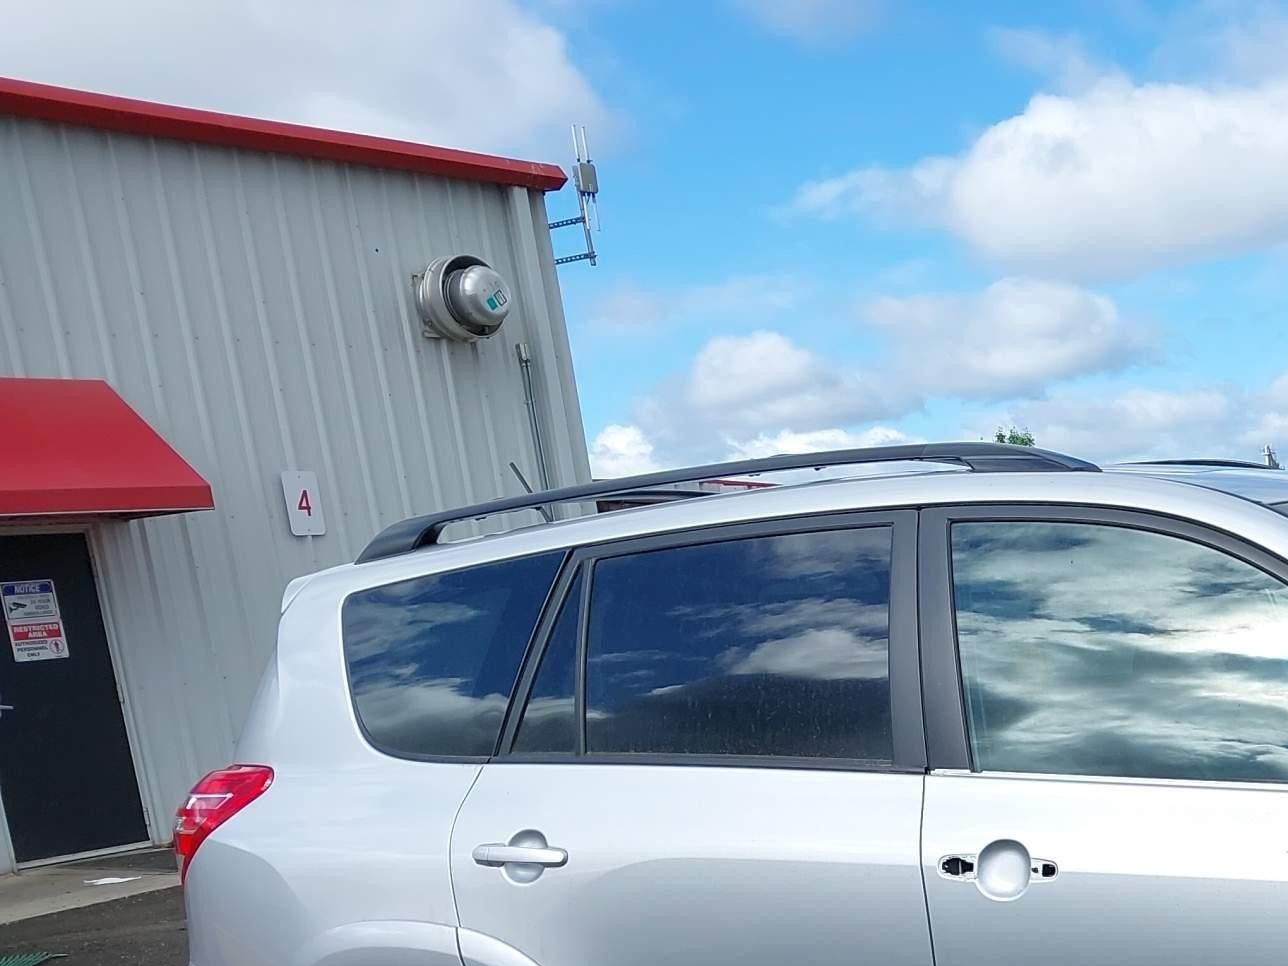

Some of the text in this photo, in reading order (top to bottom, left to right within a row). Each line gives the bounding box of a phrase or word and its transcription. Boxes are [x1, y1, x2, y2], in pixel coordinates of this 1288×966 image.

[298, 490, 311, 516] 4
[15, 584, 40, 593] NOTICE
[13, 624, 59, 632] RESTRICTED
